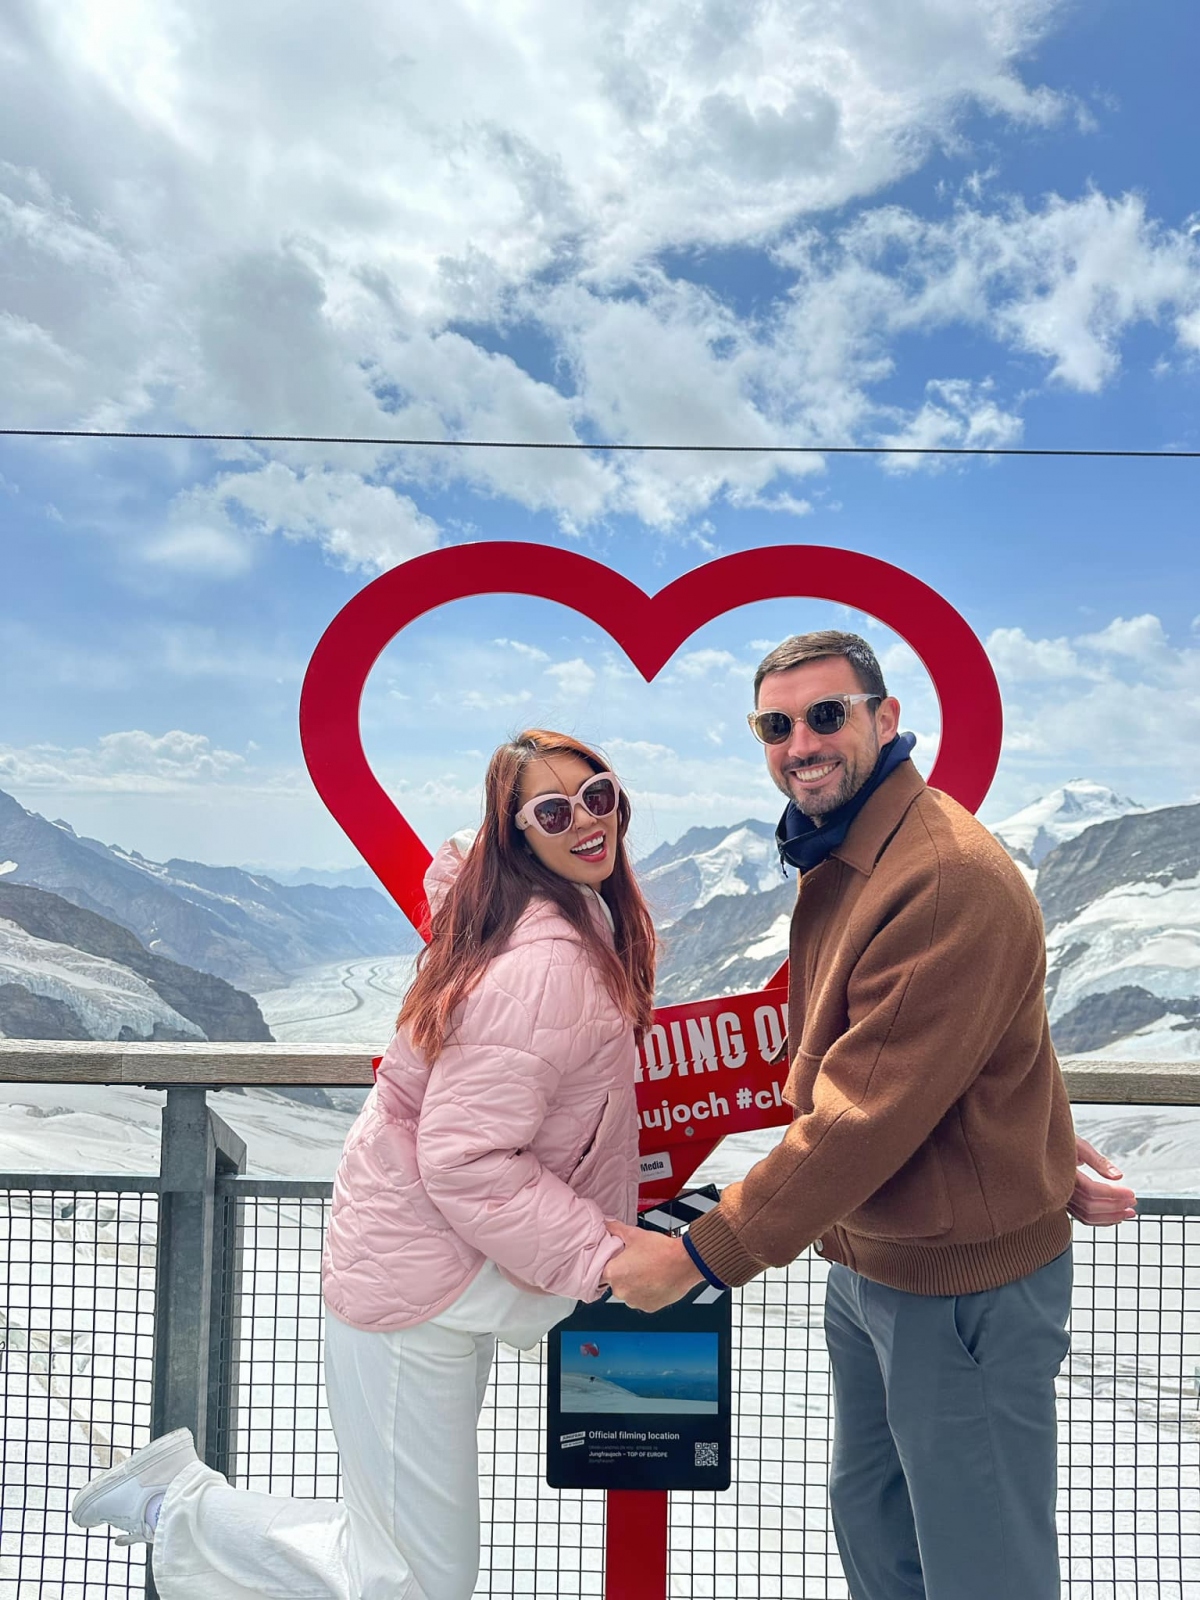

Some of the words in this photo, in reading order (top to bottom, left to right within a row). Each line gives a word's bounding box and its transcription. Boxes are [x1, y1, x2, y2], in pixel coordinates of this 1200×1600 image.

[736, 1081, 783, 1109] #cl
[640, 1160, 664, 1172] Media
[589, 1431, 617, 1439] Official
[619, 1430, 647, 1442] filming
[648, 1431, 680, 1440] location
